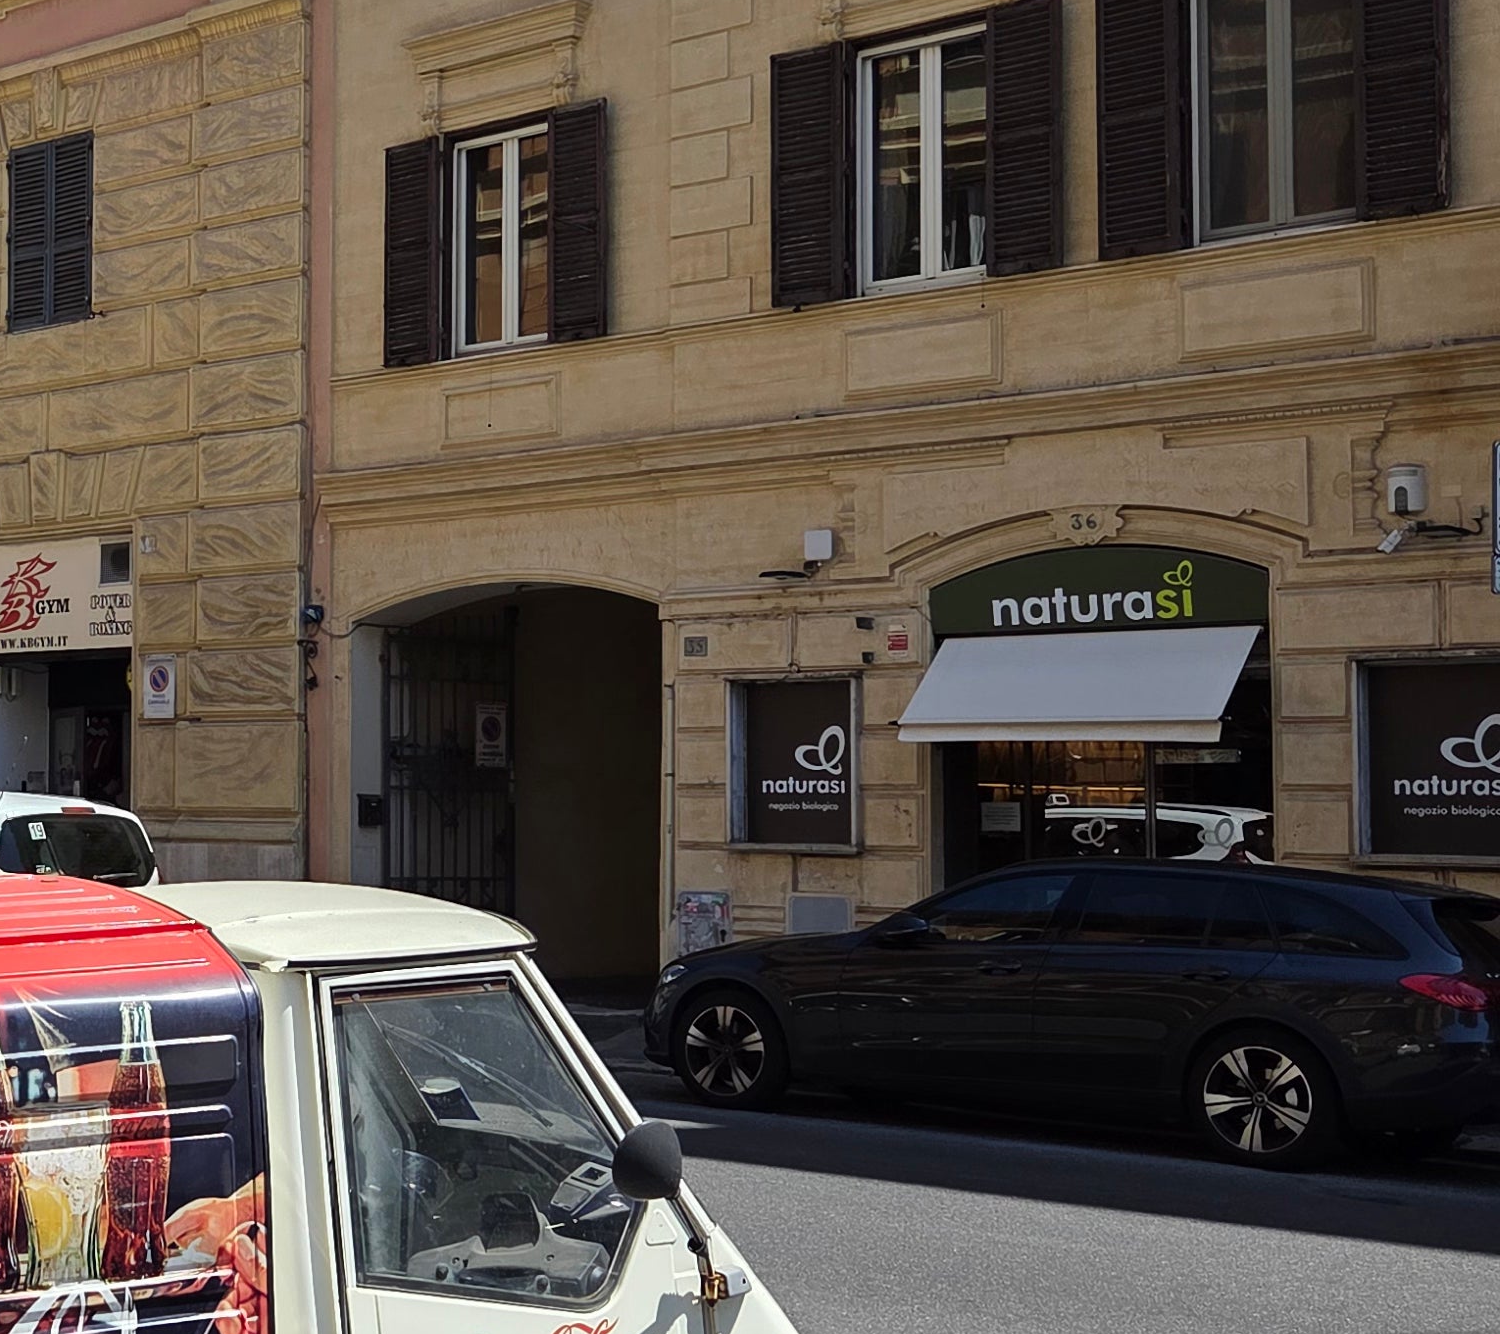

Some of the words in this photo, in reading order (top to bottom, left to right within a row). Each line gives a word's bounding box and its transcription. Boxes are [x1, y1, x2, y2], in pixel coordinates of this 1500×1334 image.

[1070, 513, 1098, 530] 36
[35, 598, 70, 615] GYM
[90, 593, 132, 609] POWER
[89, 621, 133, 636] BOXING
[768, 801, 800, 812] negozio
[802, 800, 839, 812] biologico
[1404, 805, 1449, 818] negozio
[31, 823, 44, 838] 19
